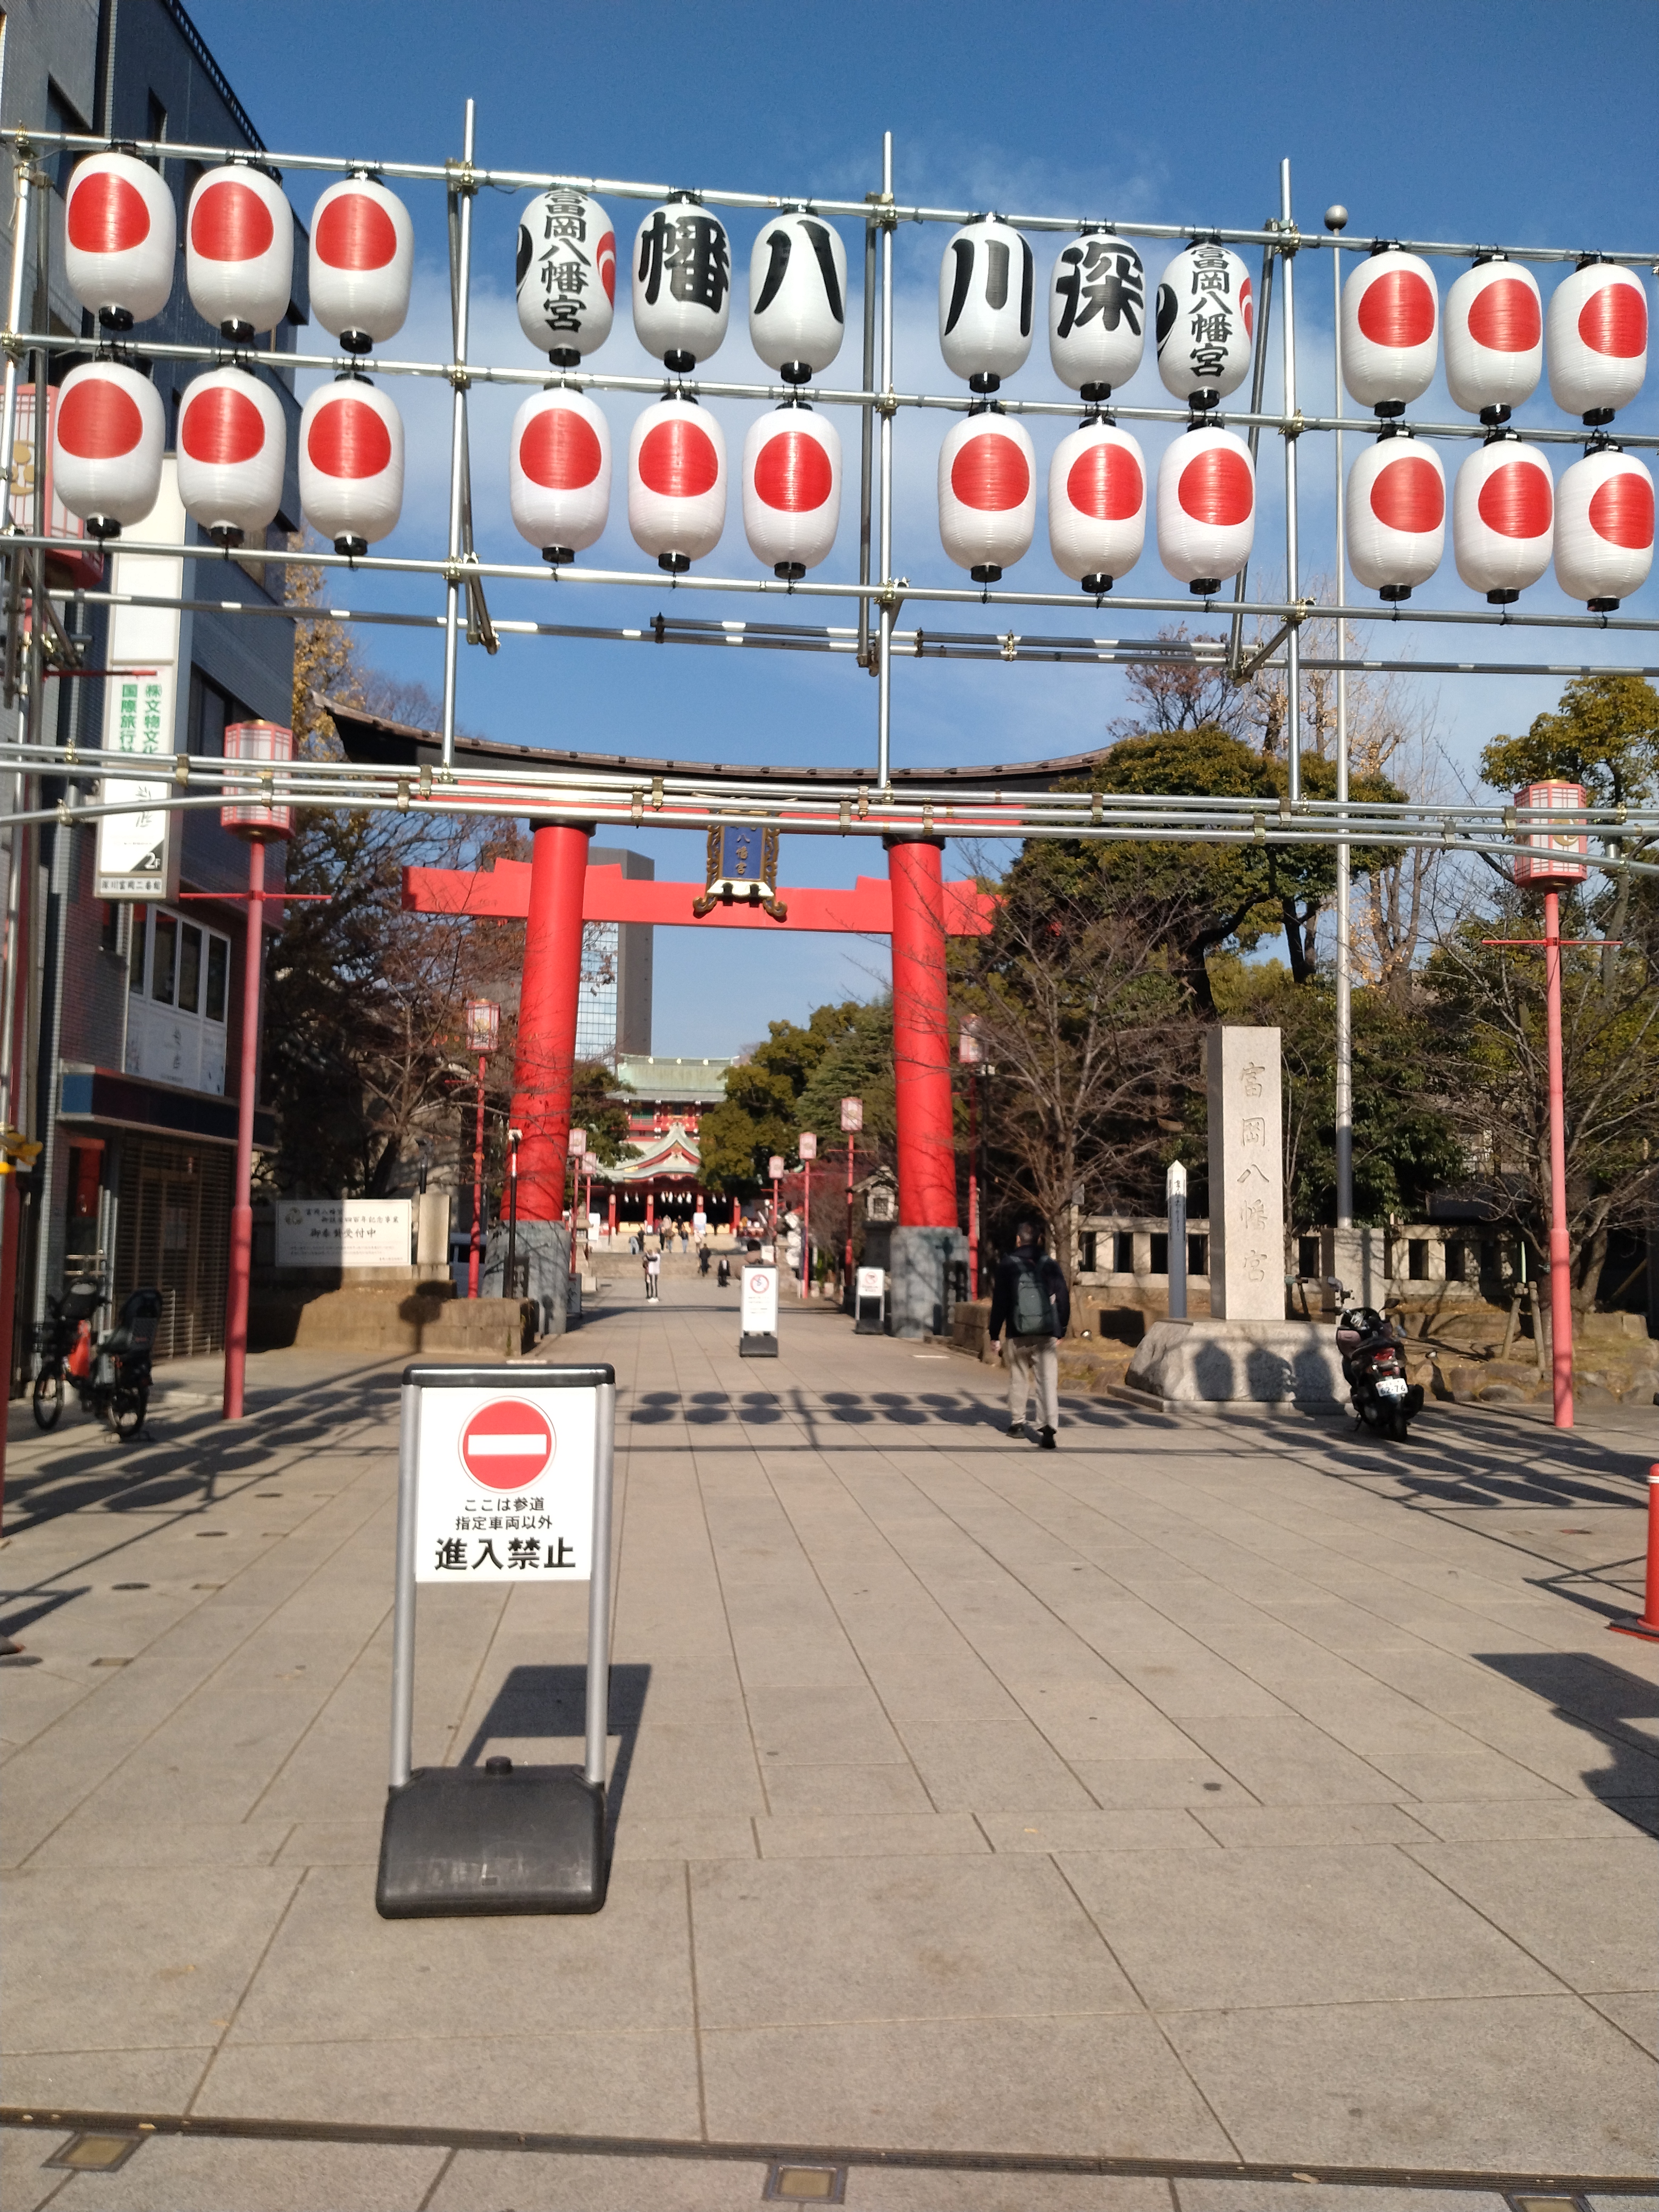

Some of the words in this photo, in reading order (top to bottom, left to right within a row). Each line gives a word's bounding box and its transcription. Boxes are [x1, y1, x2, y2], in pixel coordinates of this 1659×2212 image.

[538, 189, 591, 333] 富岡八幡宮
[638, 211, 730, 313] 幡
[754, 220, 844, 324] 八
[944, 234, 1033, 337] 川
[1055, 241, 1145, 338] 深
[1188, 246, 1234, 378] 富岡八幡宮
[144, 852, 161, 869] 2F
[1237, 1061, 1270, 1283] 富岡八幡宮
[434, 1536, 576, 1571] 進入禁止
[455, 1515, 552, 1531] 指定車両以外
[464, 1496, 545, 1512] ここは参道
